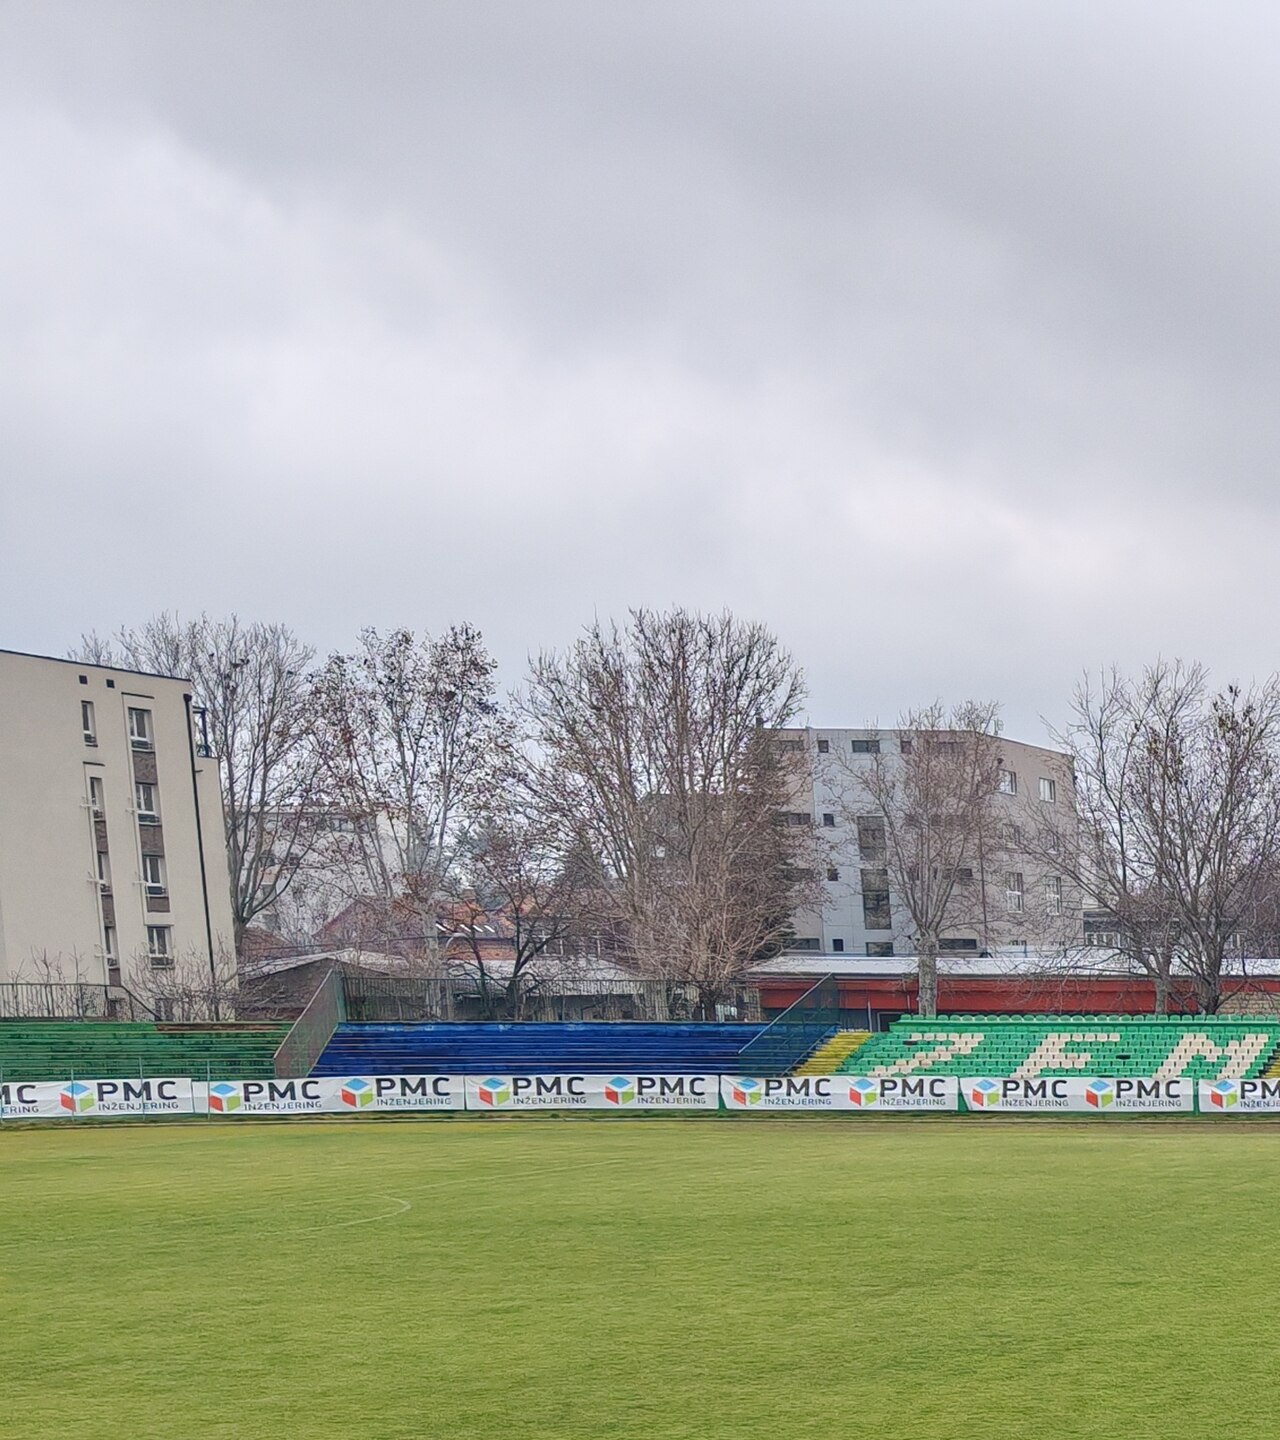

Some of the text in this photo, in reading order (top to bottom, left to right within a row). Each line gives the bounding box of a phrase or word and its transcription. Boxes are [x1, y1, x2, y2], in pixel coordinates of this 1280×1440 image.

[97, 1081, 177, 1101] PMC
[243, 1080, 321, 1101] PMC
[376, 1077, 451, 1097] PMC
[512, 1077, 585, 1096] PMC
[637, 1077, 705, 1096] PMC
[765, 1078, 832, 1097] PMC
[880, 1078, 946, 1097] PMC
[1002, 1080, 1068, 1099] PMC
[1116, 1080, 1181, 1099] PMC
[99, 1101, 178, 1111] INŽENJERING
[244, 1101, 322, 1110] INŽENJERING
[376, 1097, 452, 1106] INŽENJERING
[513, 1096, 587, 1104] INŽENJERING
[637, 1096, 706, 1105] INŽENJERING
[764, 1097, 832, 1106] INŽENJERING
[880, 1097, 946, 1106] INŽENJERING
[1001, 1099, 1069, 1107] INŽENJERING
[1116, 1099, 1181, 1108] INŽENJERING
